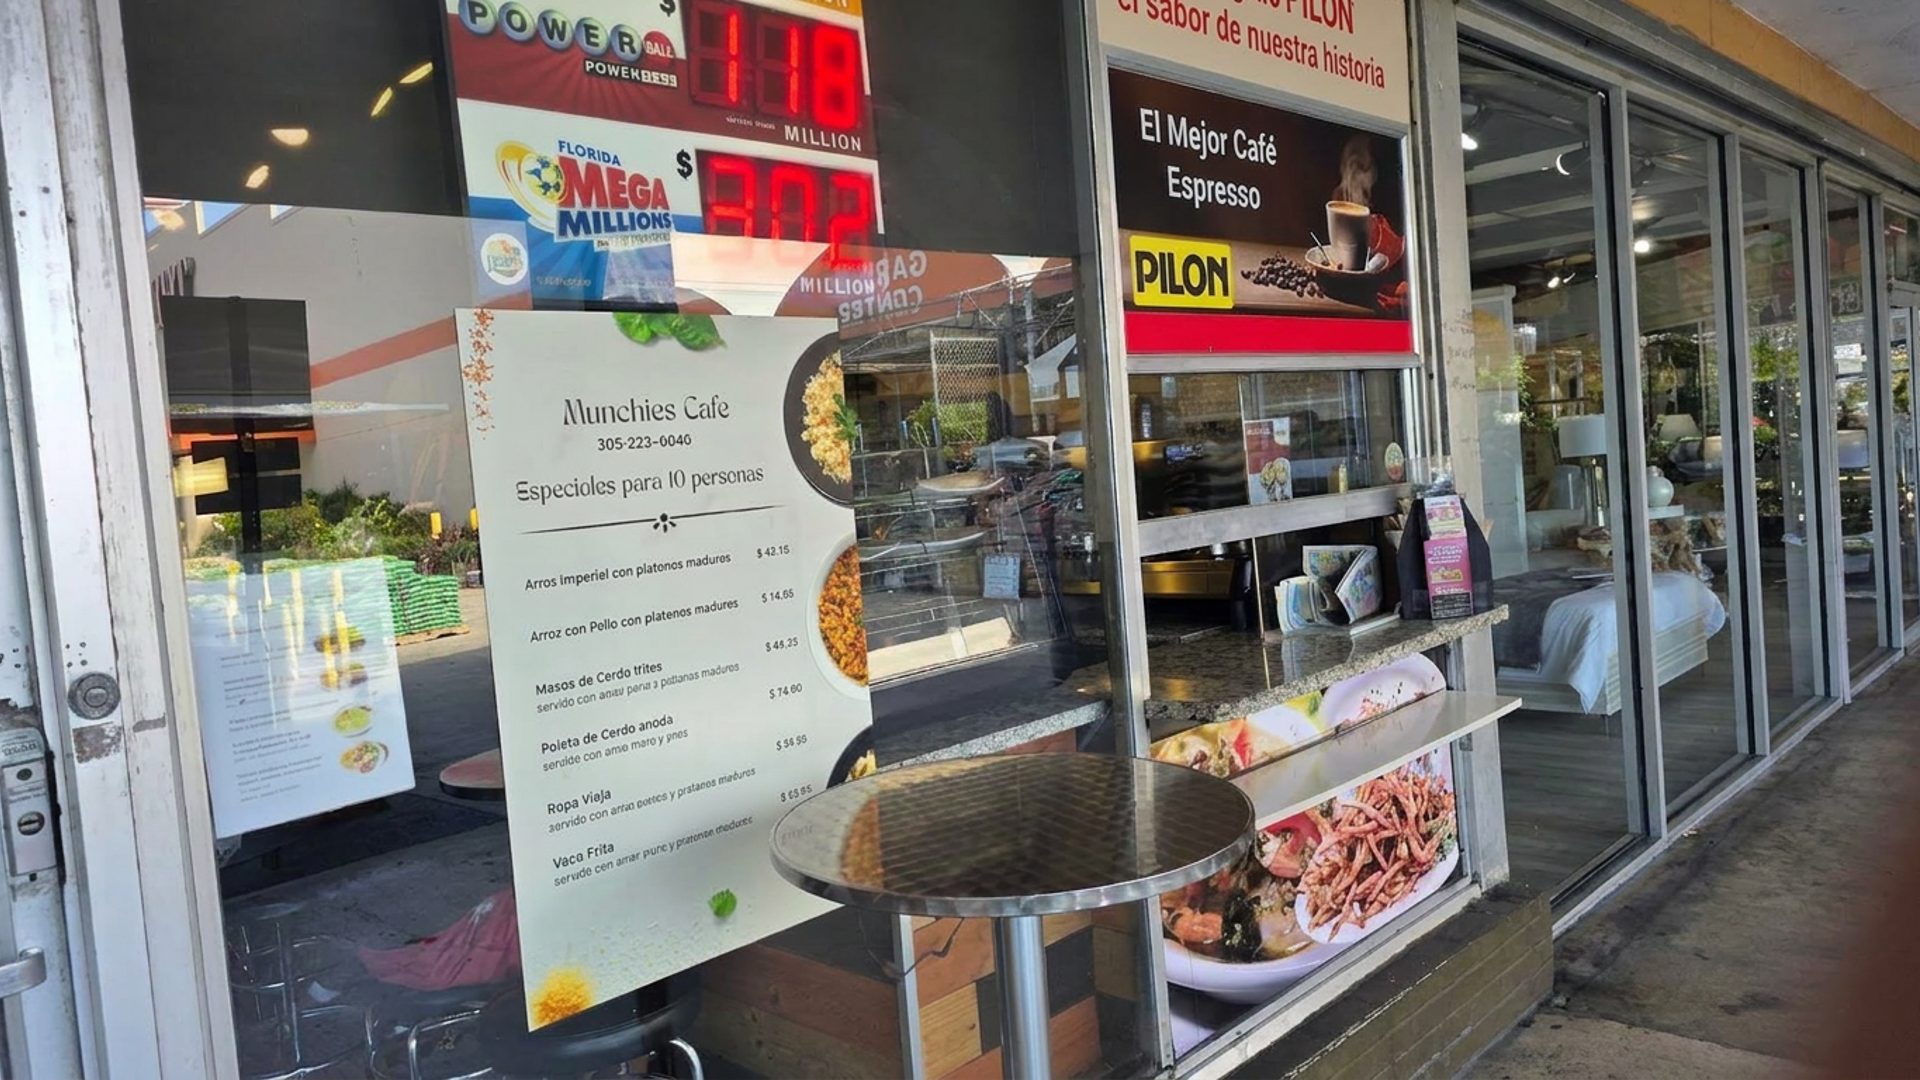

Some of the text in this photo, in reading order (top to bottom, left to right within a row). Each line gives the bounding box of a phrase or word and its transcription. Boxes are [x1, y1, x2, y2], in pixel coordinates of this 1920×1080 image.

[468, 1, 637, 54] POWER
[1217, 8, 1241, 45] de
[1248, 25, 1319, 69] nuestra
[1323, 41, 1385, 88] historia
[728, 12, 857, 130] 118
[784, 125, 862, 151] MILLION
[1139, 107, 1278, 165] El Mejor Café
[557, 139, 622, 167] FLORIDA
[676, 149, 693, 179] $
[557, 156, 671, 210] MEGA
[1167, 165, 1262, 210] Espresso
[558, 209, 673, 238] MILLIONS
[800, 276, 875, 296] MILLION
[1135, 251, 1230, 298] PILON
[563, 395, 730, 425] Munchies Cafe
[622, 475, 663, 498] para
[525, 578, 557, 590] Arros
[612, 567, 633, 578] con
[530, 630, 562, 642] Arroz
[565, 625, 586, 637] con
[621, 616, 642, 627] con
[578, 675, 594, 688] de
[596, 668, 631, 684] Cerdo
[583, 732, 598, 744] de
[601, 723, 636, 740] Cerdo
[547, 798, 579, 814] Ropa
[589, 808, 609, 821] con
[587, 842, 615, 859] Frita
